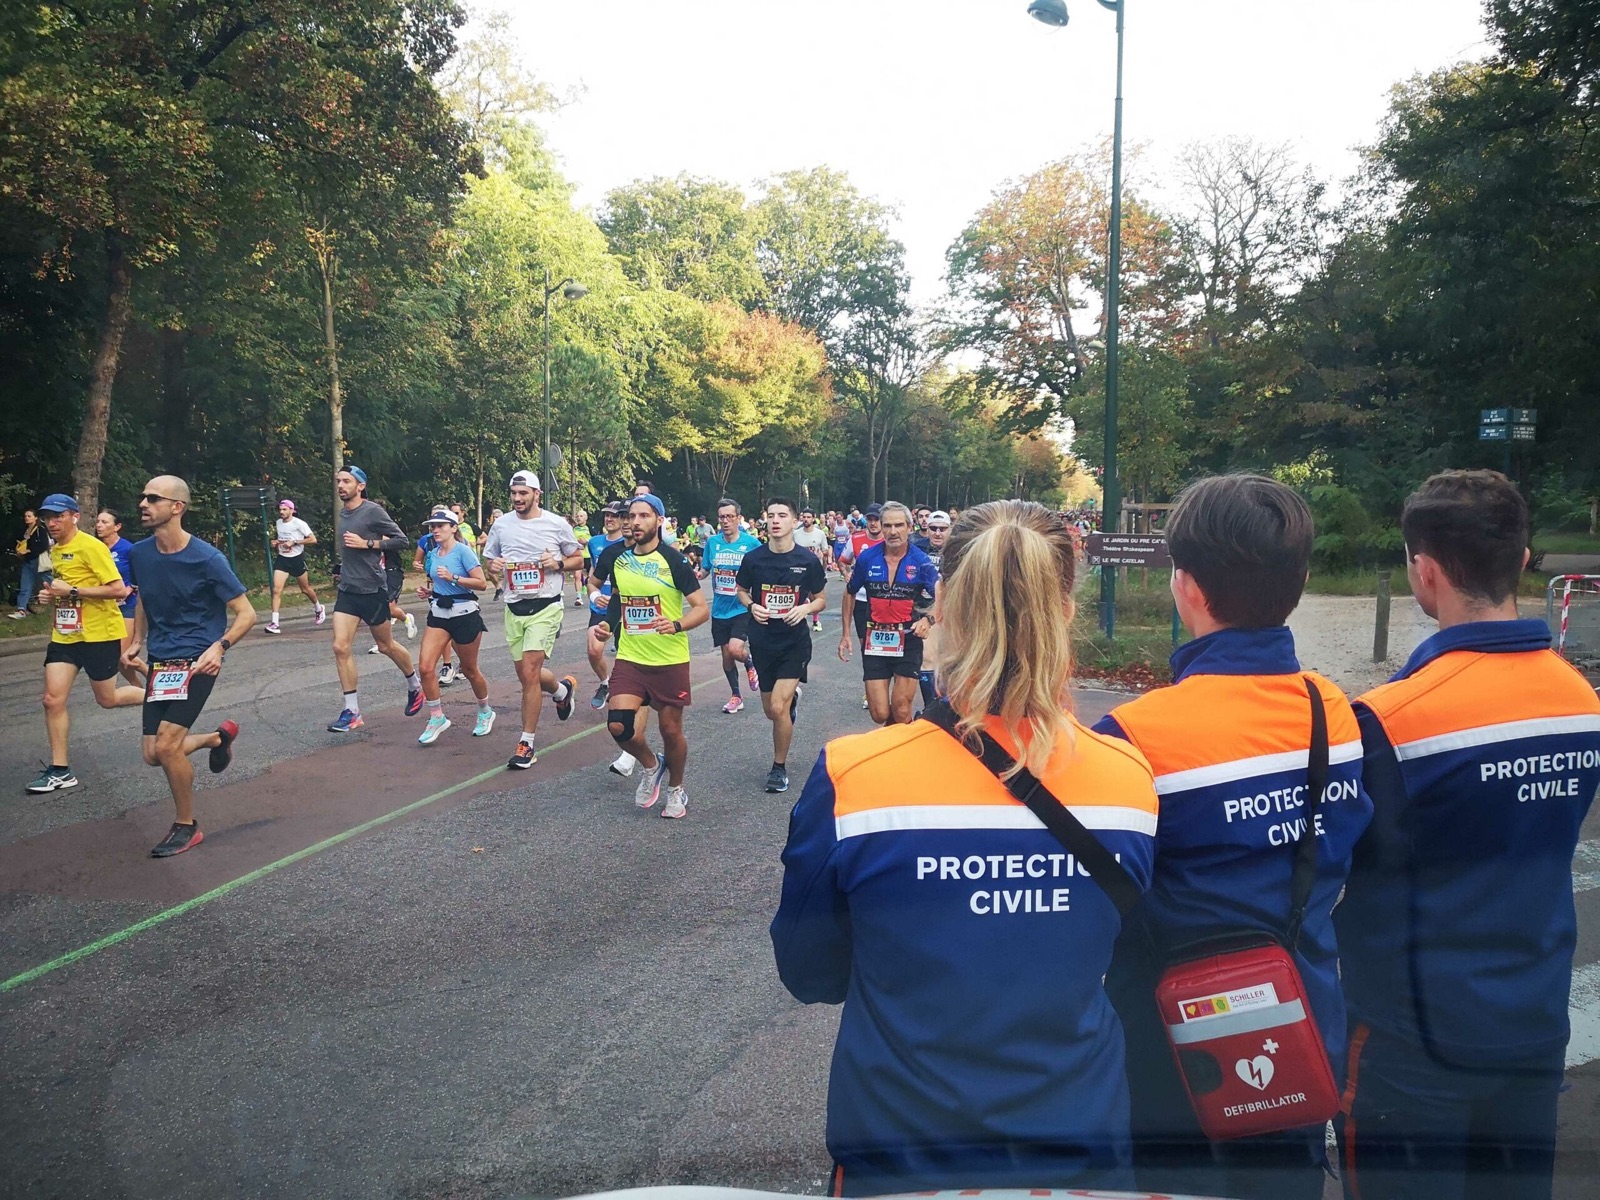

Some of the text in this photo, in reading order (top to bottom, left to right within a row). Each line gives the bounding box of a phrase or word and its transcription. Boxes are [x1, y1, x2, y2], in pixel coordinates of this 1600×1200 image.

[513, 571, 538, 580] 11115
[716, 576, 735, 585] 14059
[767, 595, 794, 604] 21805
[627, 608, 655, 618] 10778
[874, 632, 895, 641] 9787
[158, 673, 184, 683] 2332
[1517, 778, 1580, 802] CIVILE
[969, 888, 1070, 914] CIVILE
[1230, 990, 1265, 1003] SCHILLER
[1223, 1092, 1307, 1117] DEFIBRILLATOR
